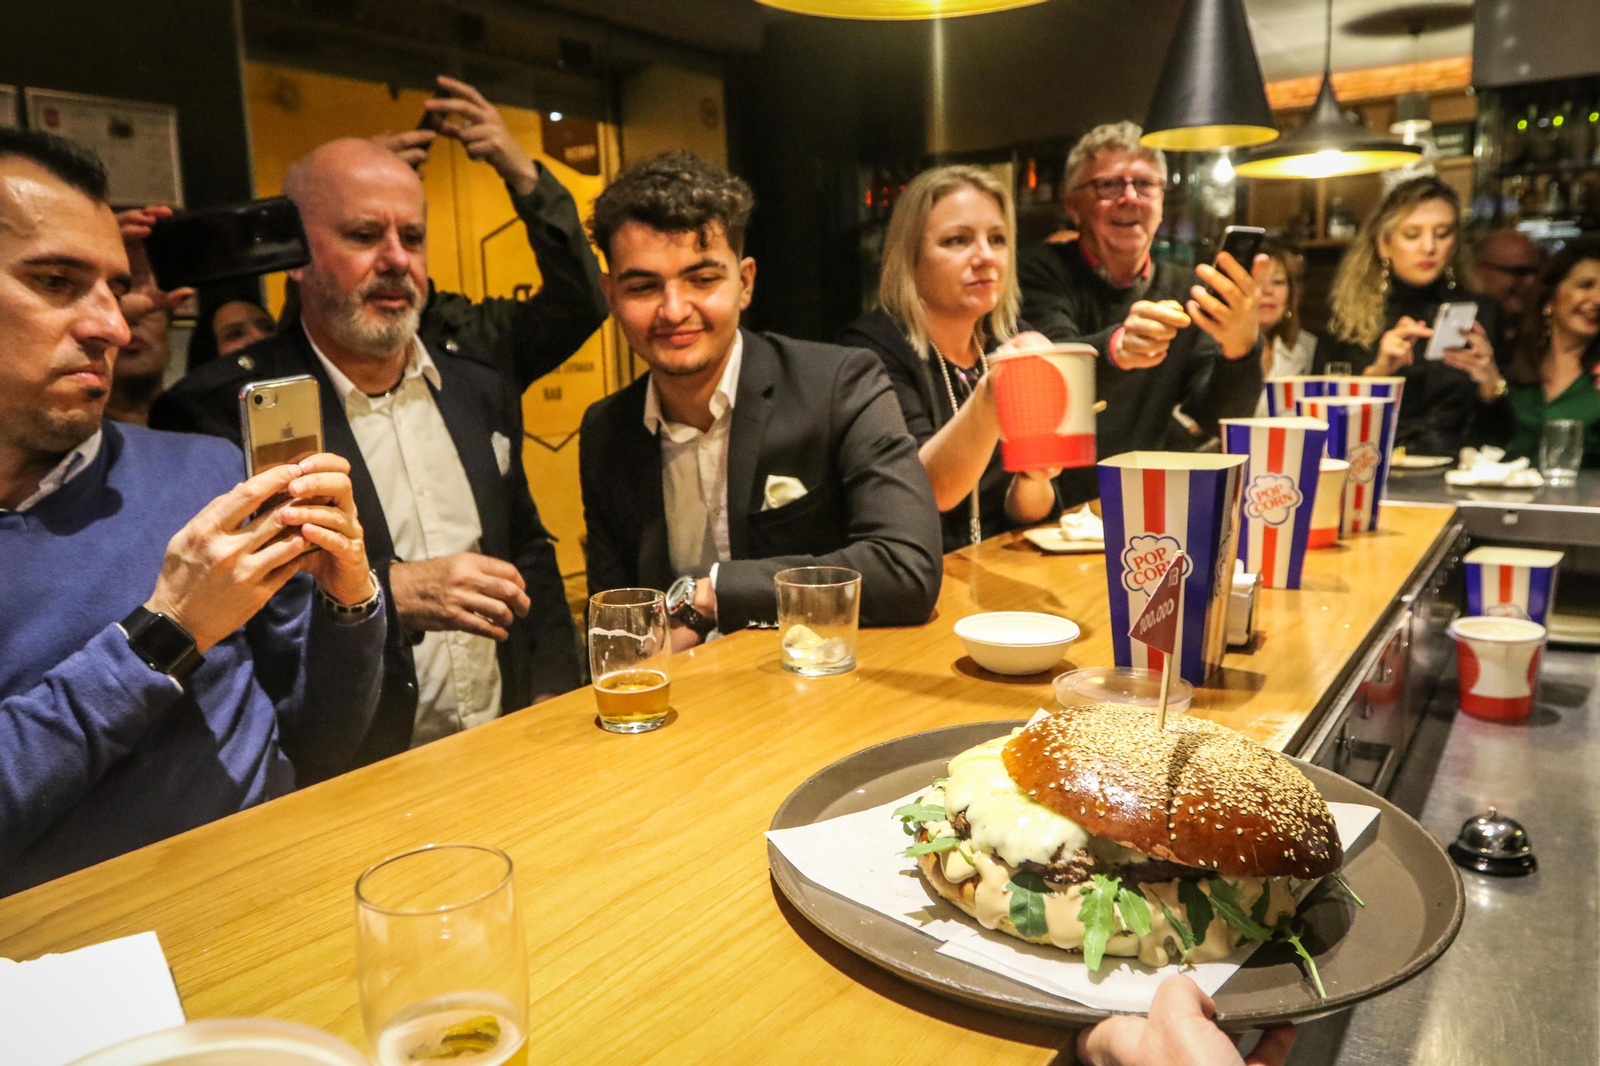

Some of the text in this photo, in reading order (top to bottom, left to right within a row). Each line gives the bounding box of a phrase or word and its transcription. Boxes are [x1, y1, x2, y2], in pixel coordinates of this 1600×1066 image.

[1255, 492, 1294, 513] CORN
[1256, 484, 1284, 502] POP
[1133, 547, 1167, 570] POP
